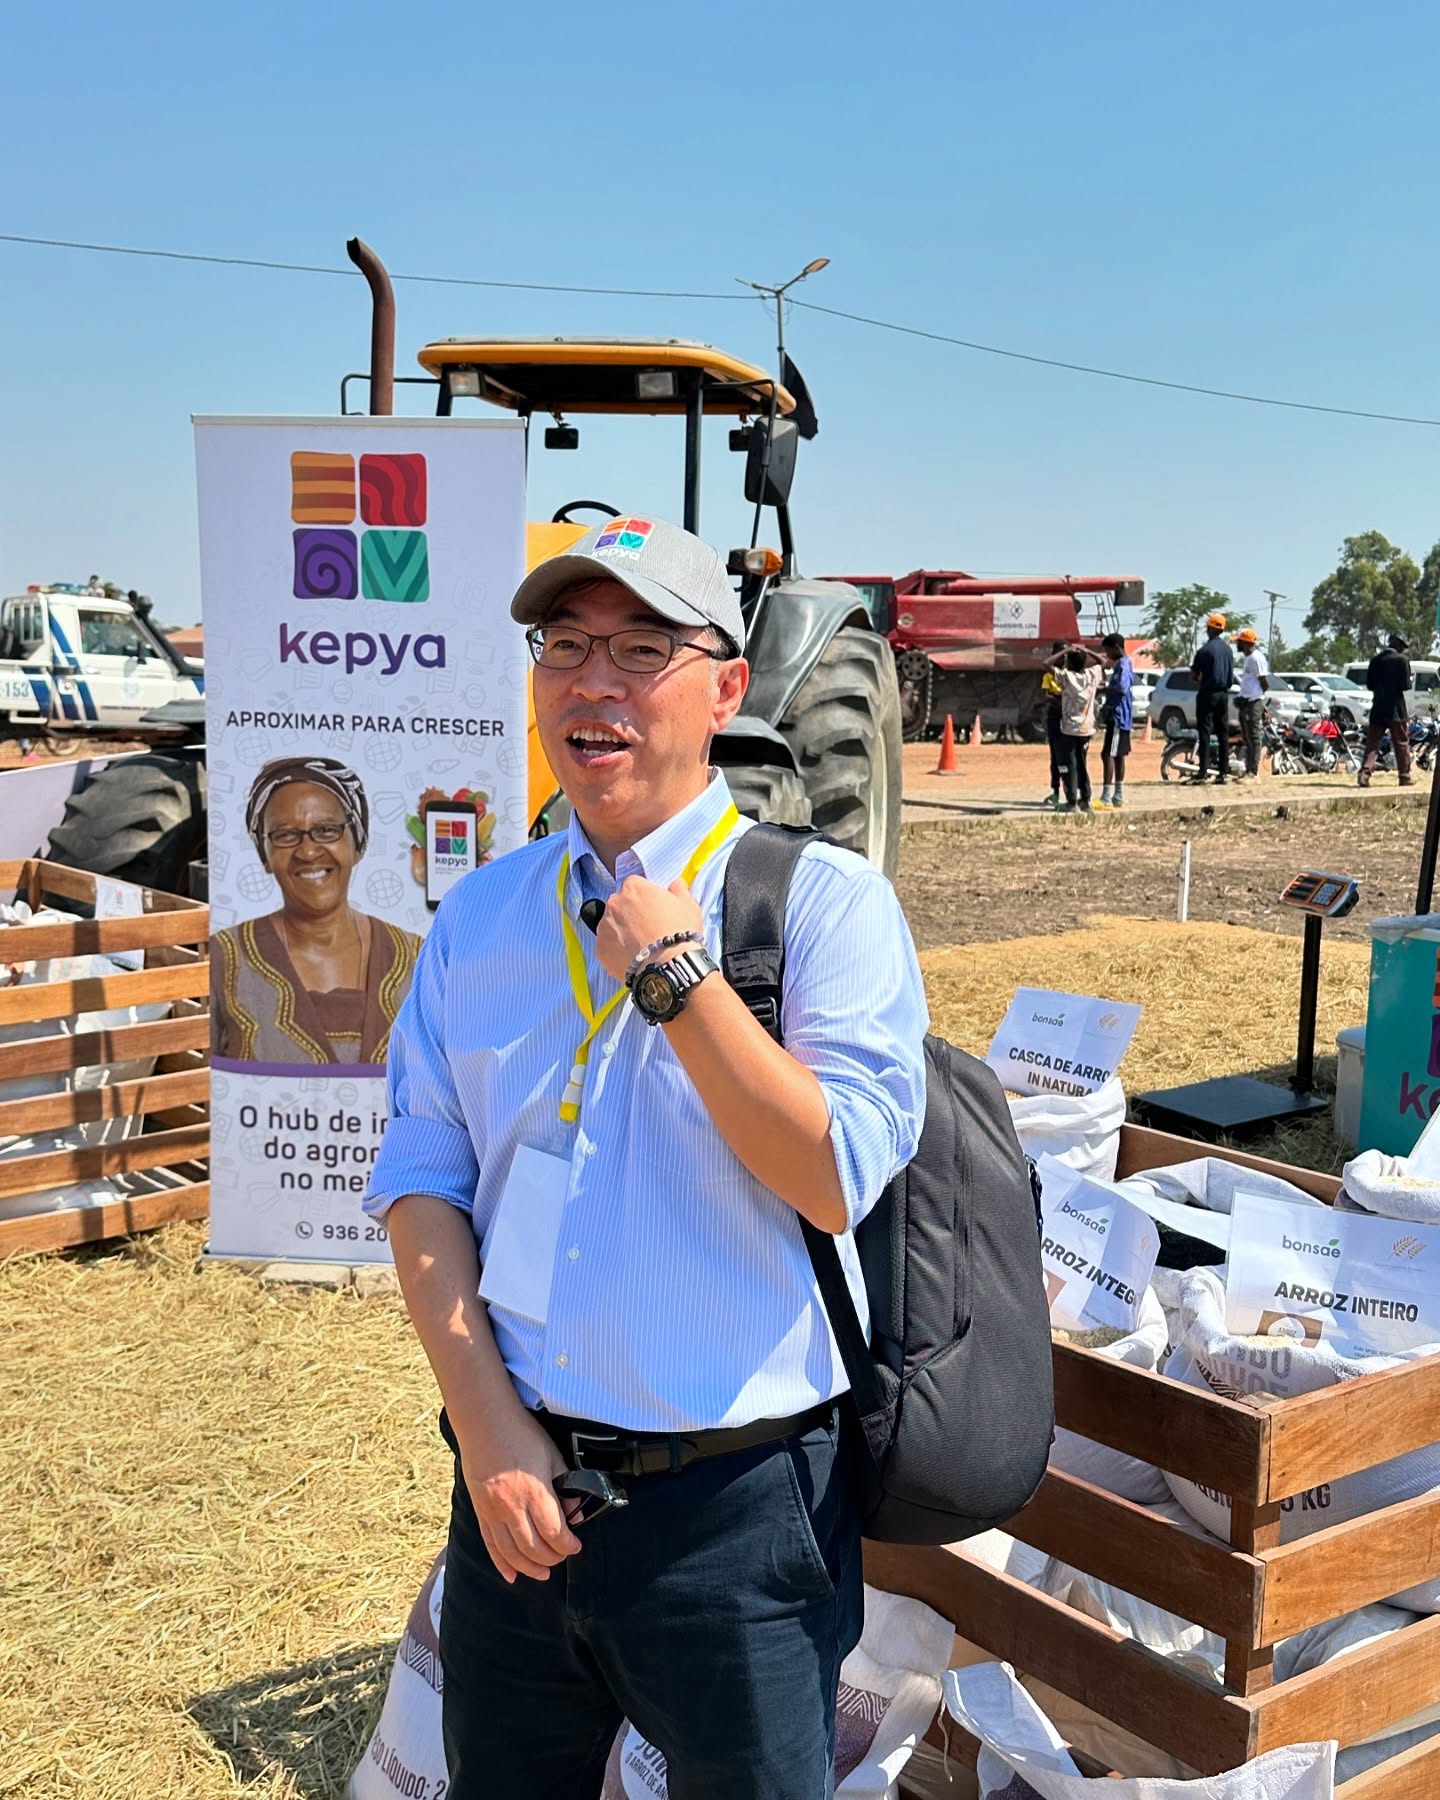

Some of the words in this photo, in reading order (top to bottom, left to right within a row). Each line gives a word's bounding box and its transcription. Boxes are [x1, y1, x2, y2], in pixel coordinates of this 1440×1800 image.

[279, 622, 447, 675] kepya
[226, 710, 345, 731] APROXIMAR
[351, 715, 406, 733] PARA
[411, 717, 505, 737] CRESCER
[435, 856, 468, 868] kepya
[1008, 1047, 1051, 1069] CASCA
[1053, 1058, 1073, 1074] DE
[1027, 1071, 1040, 1086] IN
[240, 1105, 258, 1128] O
[269, 1106, 318, 1131] hub
[329, 1109, 361, 1134] de
[264, 1136, 296, 1160] do
[280, 1172, 312, 1190] no
[323, 1225, 359, 1241] 936
[1274, 1281, 1349, 1312] ARROZ
[1351, 1296, 1419, 1323] INTEIRO
[1302, 1484, 1331, 1511] KG
